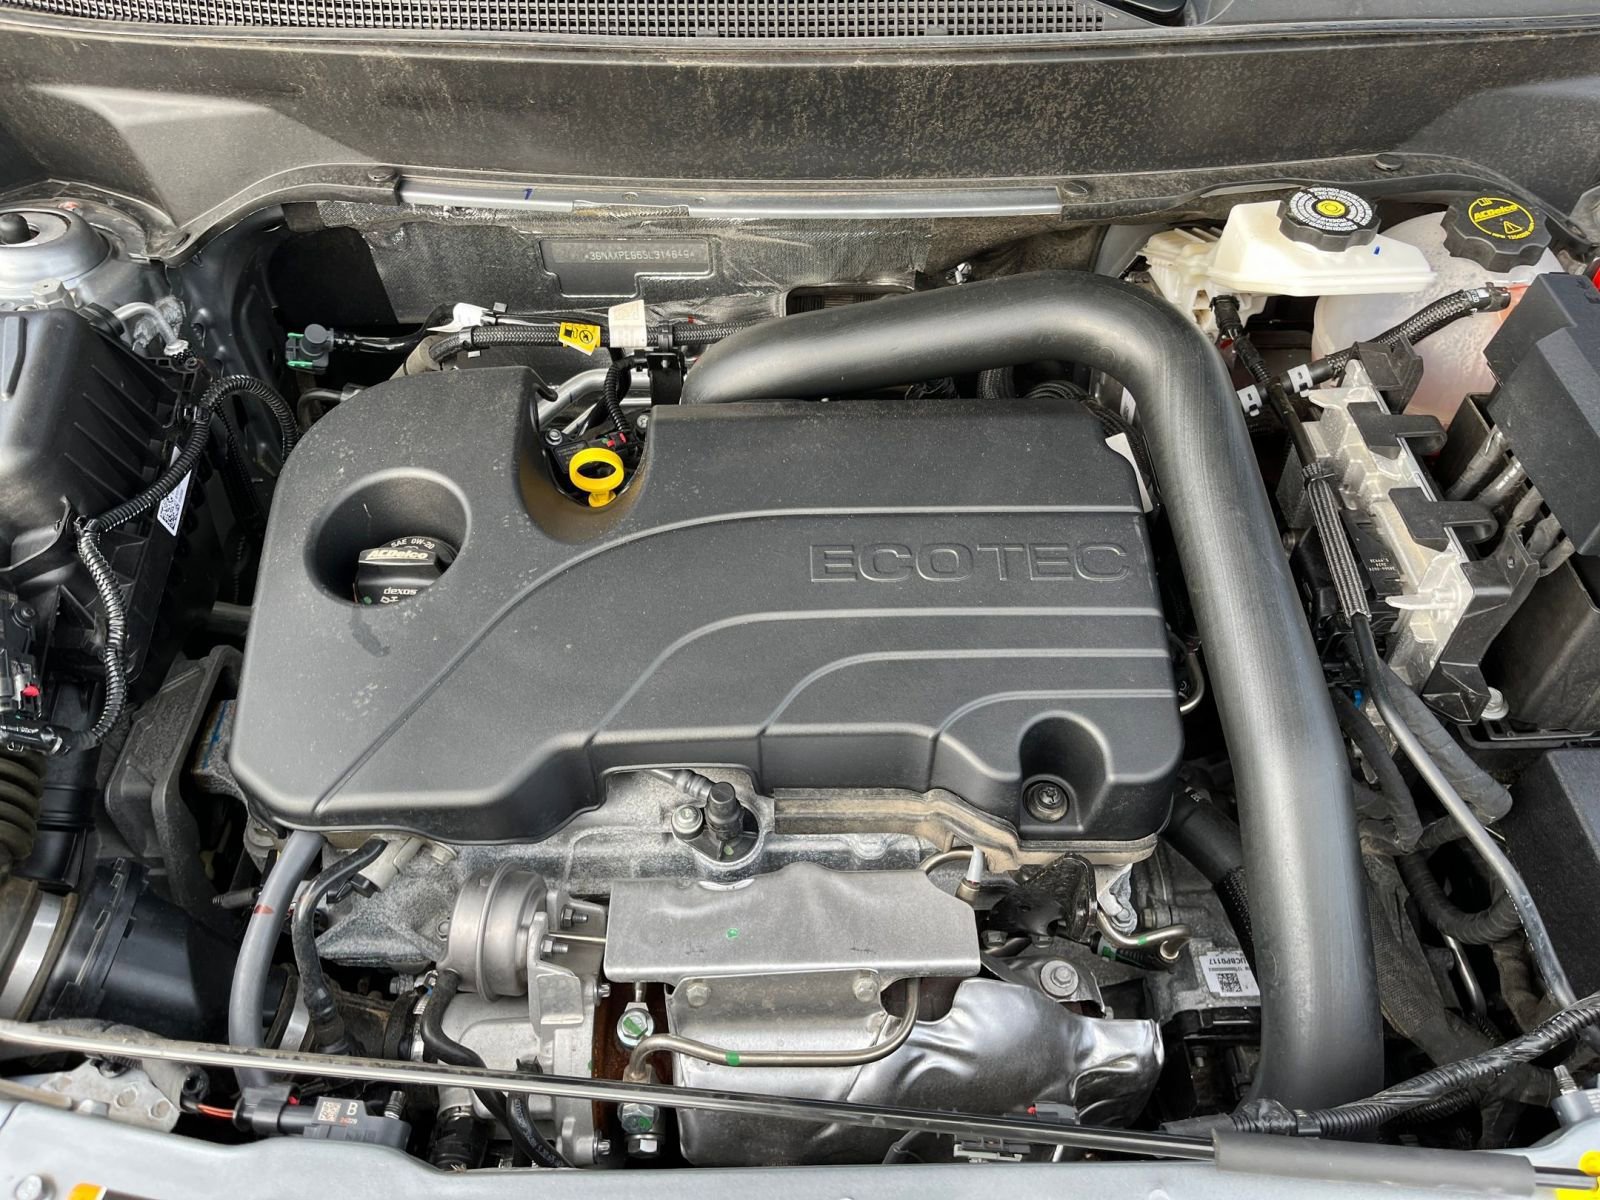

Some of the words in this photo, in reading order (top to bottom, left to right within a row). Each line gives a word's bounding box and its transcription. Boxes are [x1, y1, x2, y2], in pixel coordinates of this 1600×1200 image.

[391, 539, 407, 548] SAE
[411, 538, 435, 550] 0W-20
[809, 542, 1130, 582] ECOTEC
[383, 586, 418, 596] dexos
[346, 1102, 358, 1116] B
